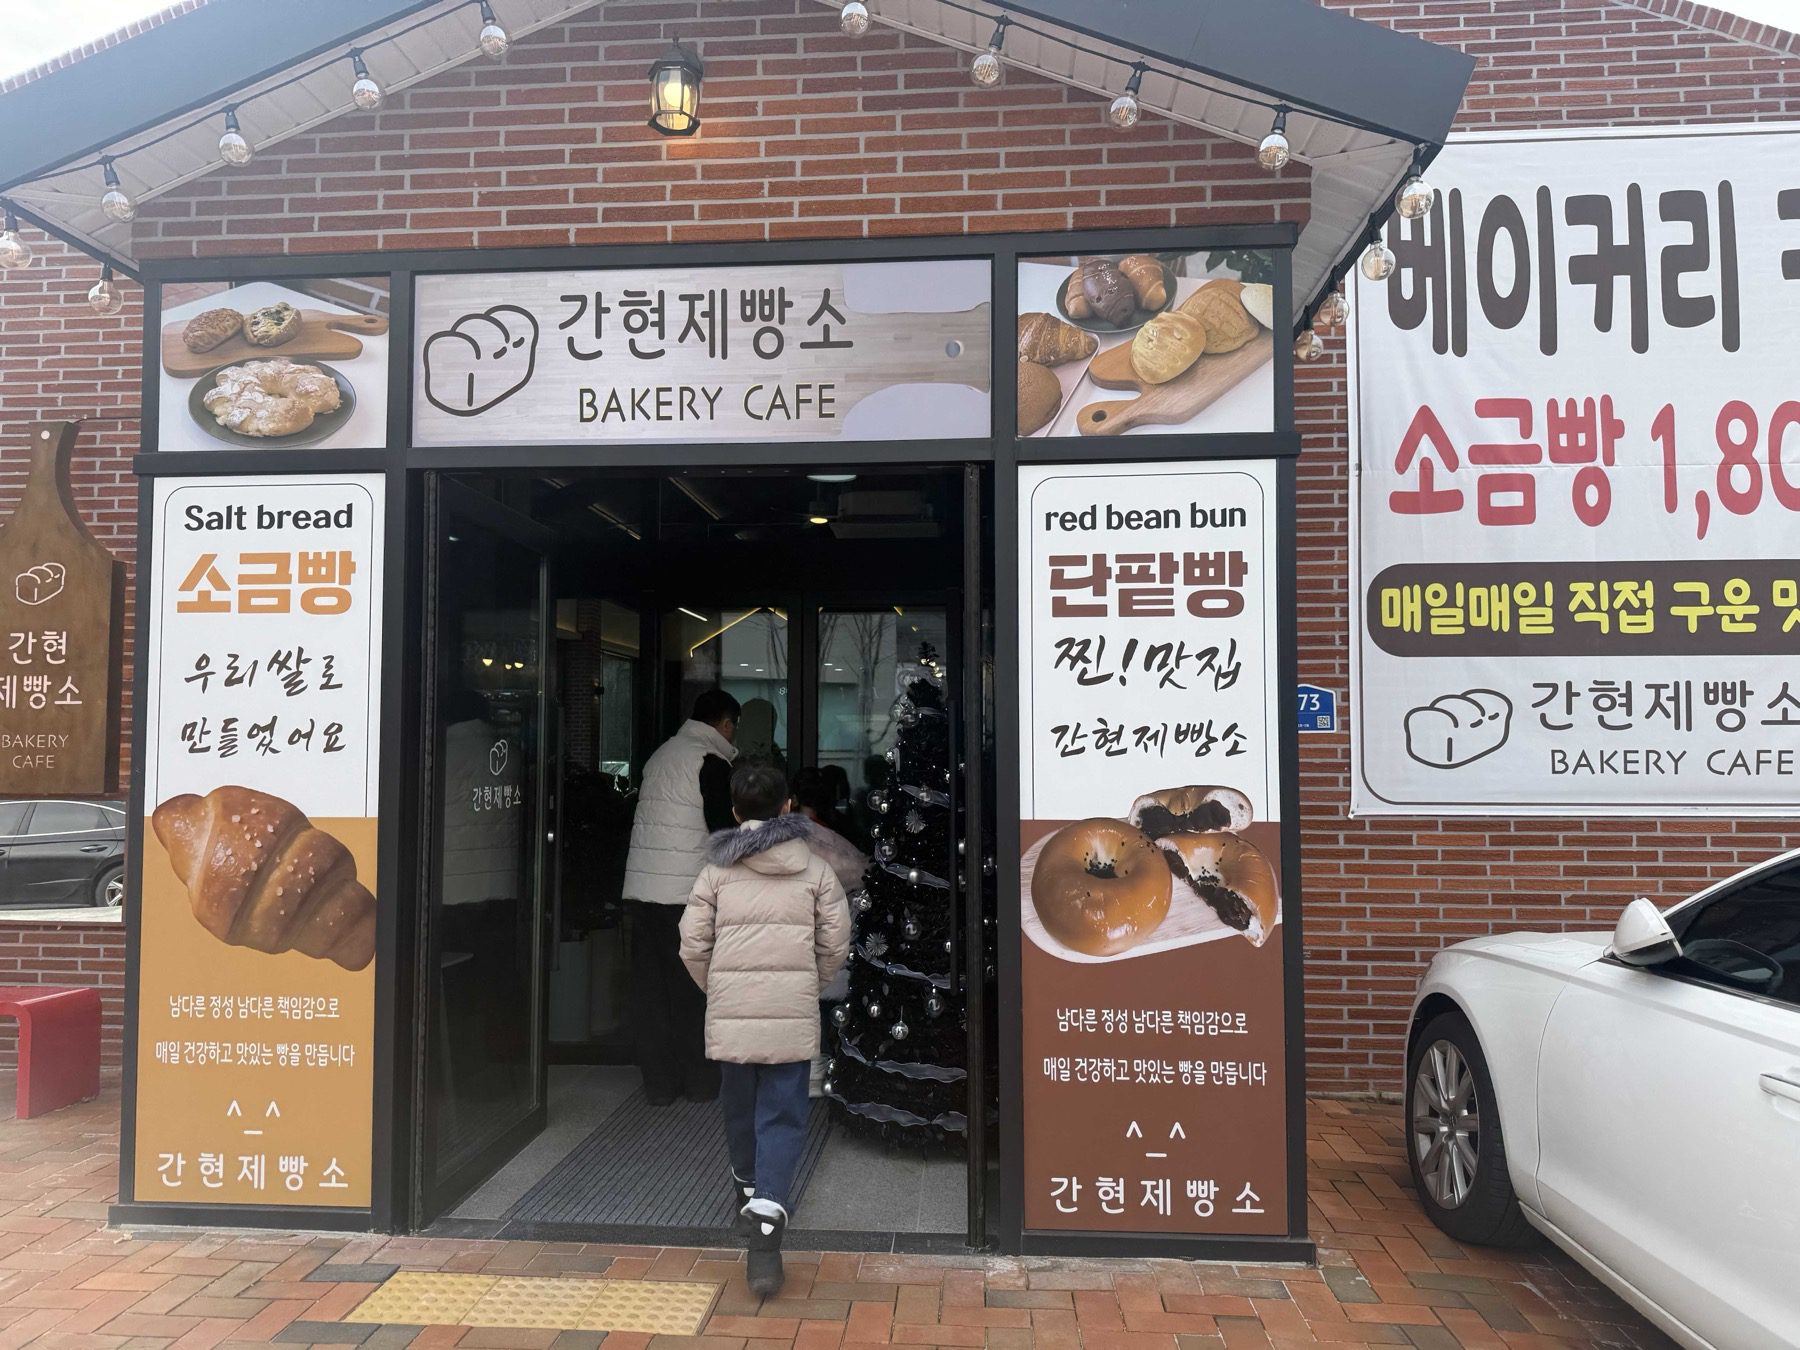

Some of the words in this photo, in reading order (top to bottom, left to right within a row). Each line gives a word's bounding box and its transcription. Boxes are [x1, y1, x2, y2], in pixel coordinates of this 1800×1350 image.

[1388, 179, 1740, 358] 베이커리
[559, 287, 854, 361] 간현제빵소
[579, 386, 724, 424] BAKERY
[743, 384, 836, 421] CAFE
[1389, 393, 1625, 528] 소금빵
[184, 504, 248, 532] Salt
[256, 502, 354, 531] bread
[1045, 504, 1097, 532] red
[1105, 503, 1181, 531] bean
[1189, 501, 1247, 528] bun
[176, 550, 357, 616] 소금빵
[1048, 550, 1248, 619] 단팥빵
[1381, 580, 1555, 636] 매일매일
[1568, 579, 1655, 635] 직접
[1669, 577, 1761, 634] 구운
[8, 630, 67, 665] 간현
[0, 674, 83, 710] 제빵소
[1531, 679, 1800, 733] 간현제빵소
[1, 734, 69, 748] BAKERY
[181, 714, 347, 759] 만들었어요
[1050, 717, 1248, 759] 간현제빵소
[12, 754, 55, 769] CAFE
[1551, 748, 1688, 777] BAKERY
[1706, 748, 1794, 776] CAFE
[472, 784, 521, 812] 간현제빵소
[169, 995, 207, 1018] 남다른
[209, 995, 234, 1019] 정성
[237, 996, 275, 1019] 남다른
[277, 996, 340, 1020] 책임감으로
[1056, 1008, 1098, 1032] 남다른
[1101, 1009, 1128, 1034] 정성
[1132, 1010, 1174, 1034] 남다른
[1177, 1010, 1249, 1036] 책임감으로
[155, 1041, 180, 1065] 매일
[183, 1042, 233, 1066] 건강하고
[236, 1042, 274, 1066] 맛있는
[276, 1043, 302, 1067] 빵을
[304, 1044, 356, 1067] 만듭니다
[1043, 1057, 1071, 1082] 매일
[1074, 1058, 1131, 1083] 건강하고
[1133, 1059, 1176, 1084] 맛있는
[1178, 1060, 1208, 1085] 빵을
[1210, 1061, 1268, 1087] 만듭니다
[157, 1152, 349, 1191] 간현제빵소
[1050, 1175, 1265, 1218] 간현제빵소
